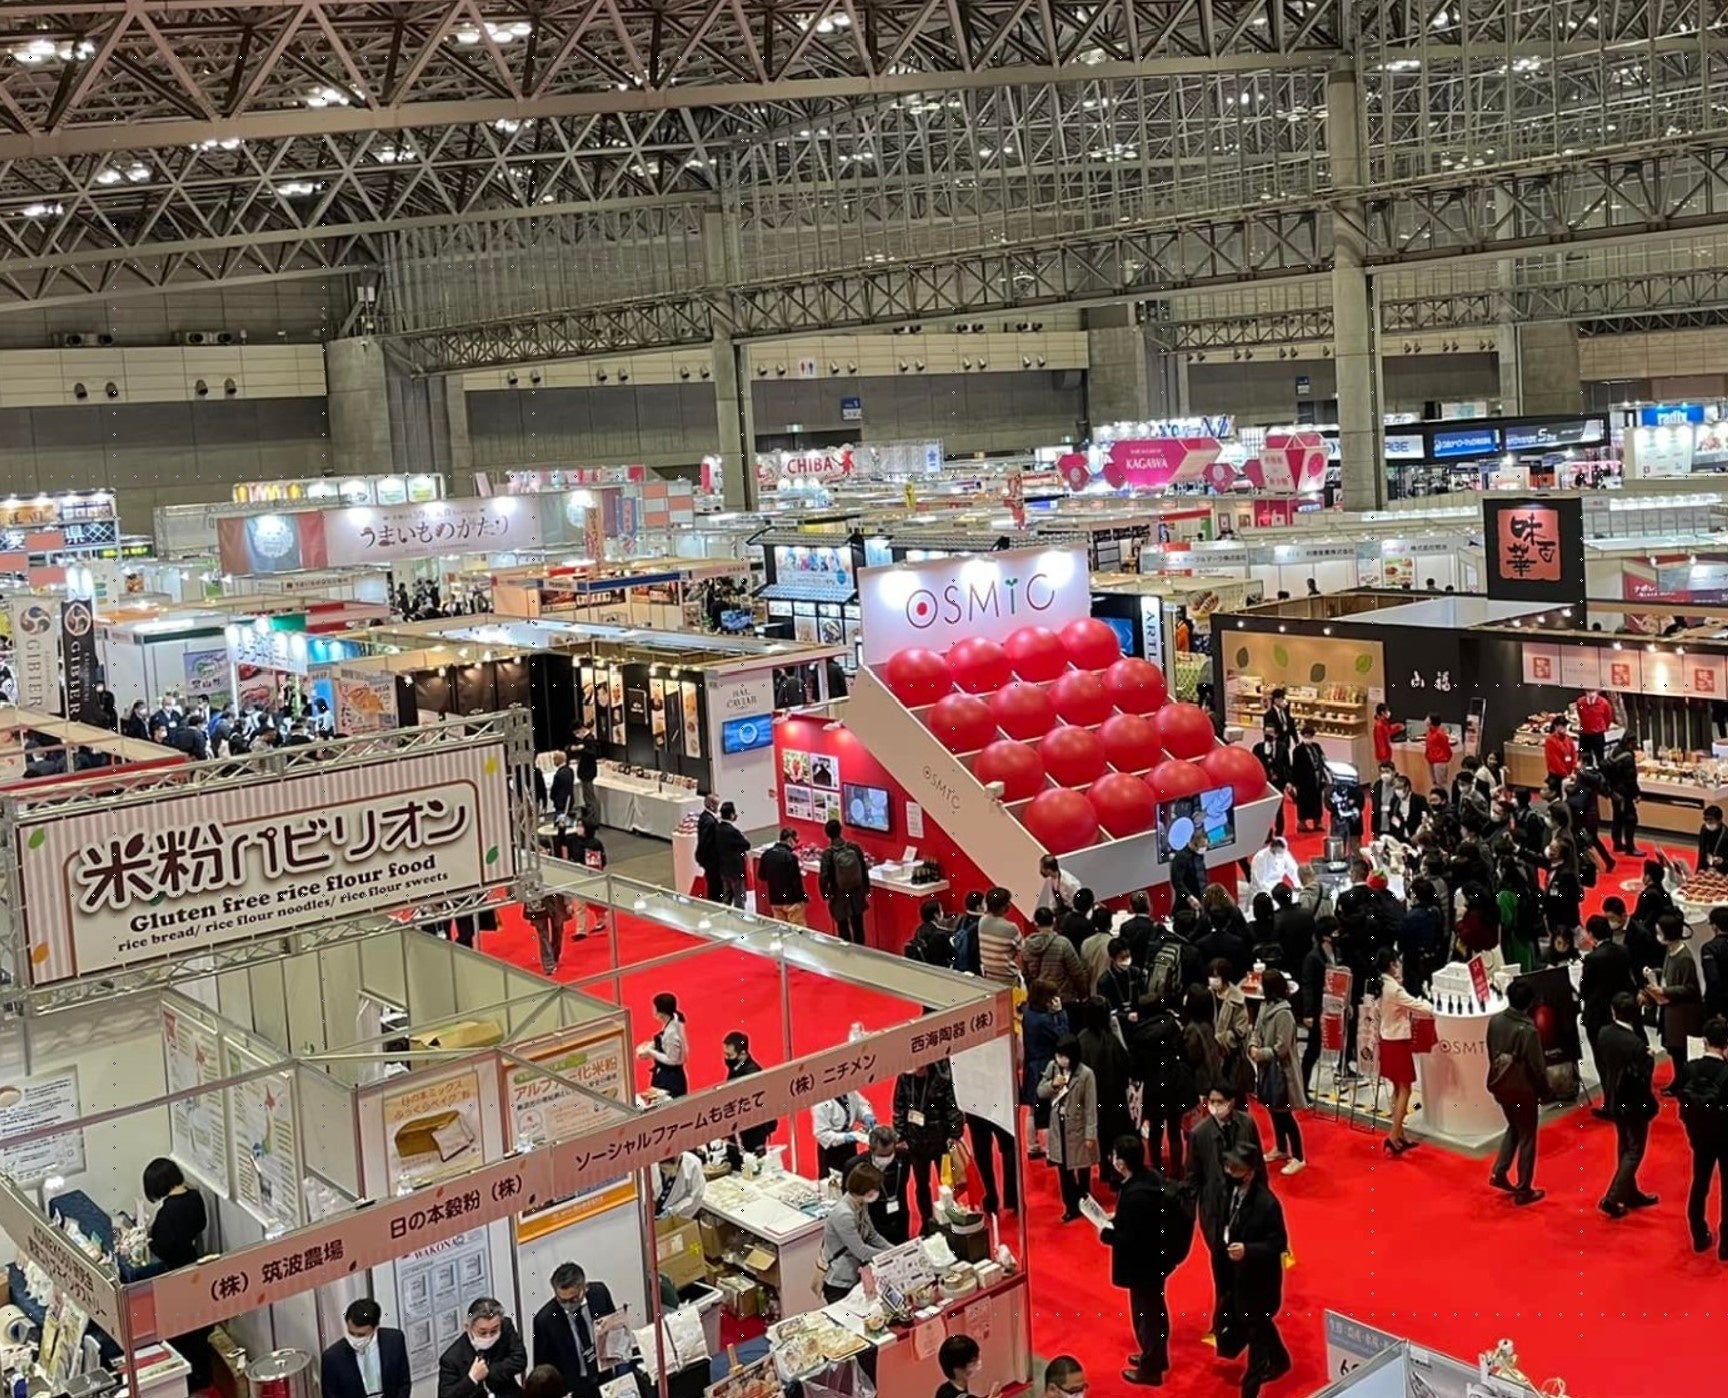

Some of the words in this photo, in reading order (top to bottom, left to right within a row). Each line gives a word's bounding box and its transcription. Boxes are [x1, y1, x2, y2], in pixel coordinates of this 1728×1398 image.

[787, 456, 833, 475] CHIBA
[1126, 458, 1169, 470] KAGAWA
[906, 573, 1055, 630] OSMIC
[26, 639, 43, 708] GIBIER
[69, 641, 81, 715] GIBIER
[80, 800, 468, 908] 米粉パビリオン
[118, 935, 148, 952] rice
[151, 924, 200, 945] bread/
[205, 919, 234, 934] rice
[236, 911, 274, 926] flour
[277, 895, 336, 918] noodles/
[340, 891, 366, 904] rice
[368, 882, 402, 898] flour
[405, 872, 449, 889] sweets
[130, 904, 217, 933] Gluten
[222, 896, 271, 914] free
[276, 884, 321, 903] rice
[326, 869, 383, 892] flour
[388, 854, 436, 878] food
[575, 1091, 766, 1171] ソーシャルファームもぎたて
